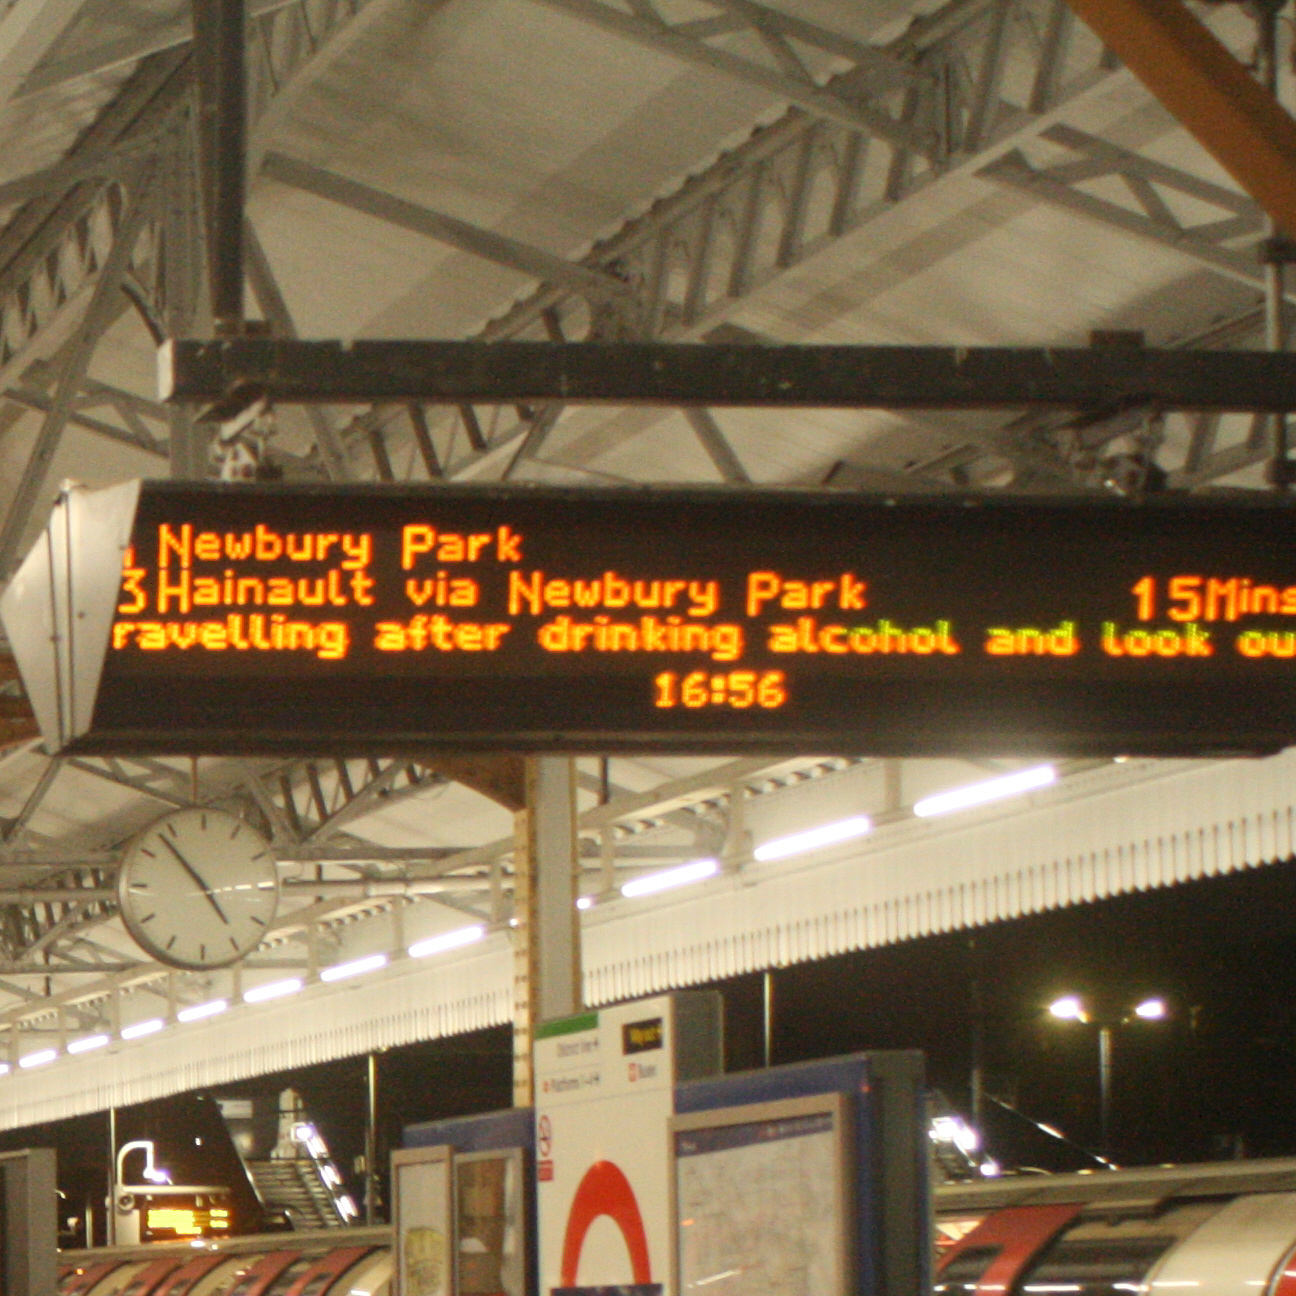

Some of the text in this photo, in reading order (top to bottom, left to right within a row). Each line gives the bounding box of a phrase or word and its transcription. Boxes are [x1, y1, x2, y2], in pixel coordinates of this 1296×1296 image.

[158, 523, 373, 570] Newbury
[401, 524, 524, 570] Park
[118, 569, 147, 613] 3
[157, 568, 375, 614] Hainault
[405, 570, 479, 607] via
[508, 570, 718, 617] Newbury
[746, 571, 867, 617] Park
[374, 613, 512, 651] after
[537, 614, 745, 661] drinking
[768, 616, 961, 655] alcohol
[984, 620, 1080, 656] and
[1101, 620, 1214, 657] look
[654, 670, 789, 709] 16:56
